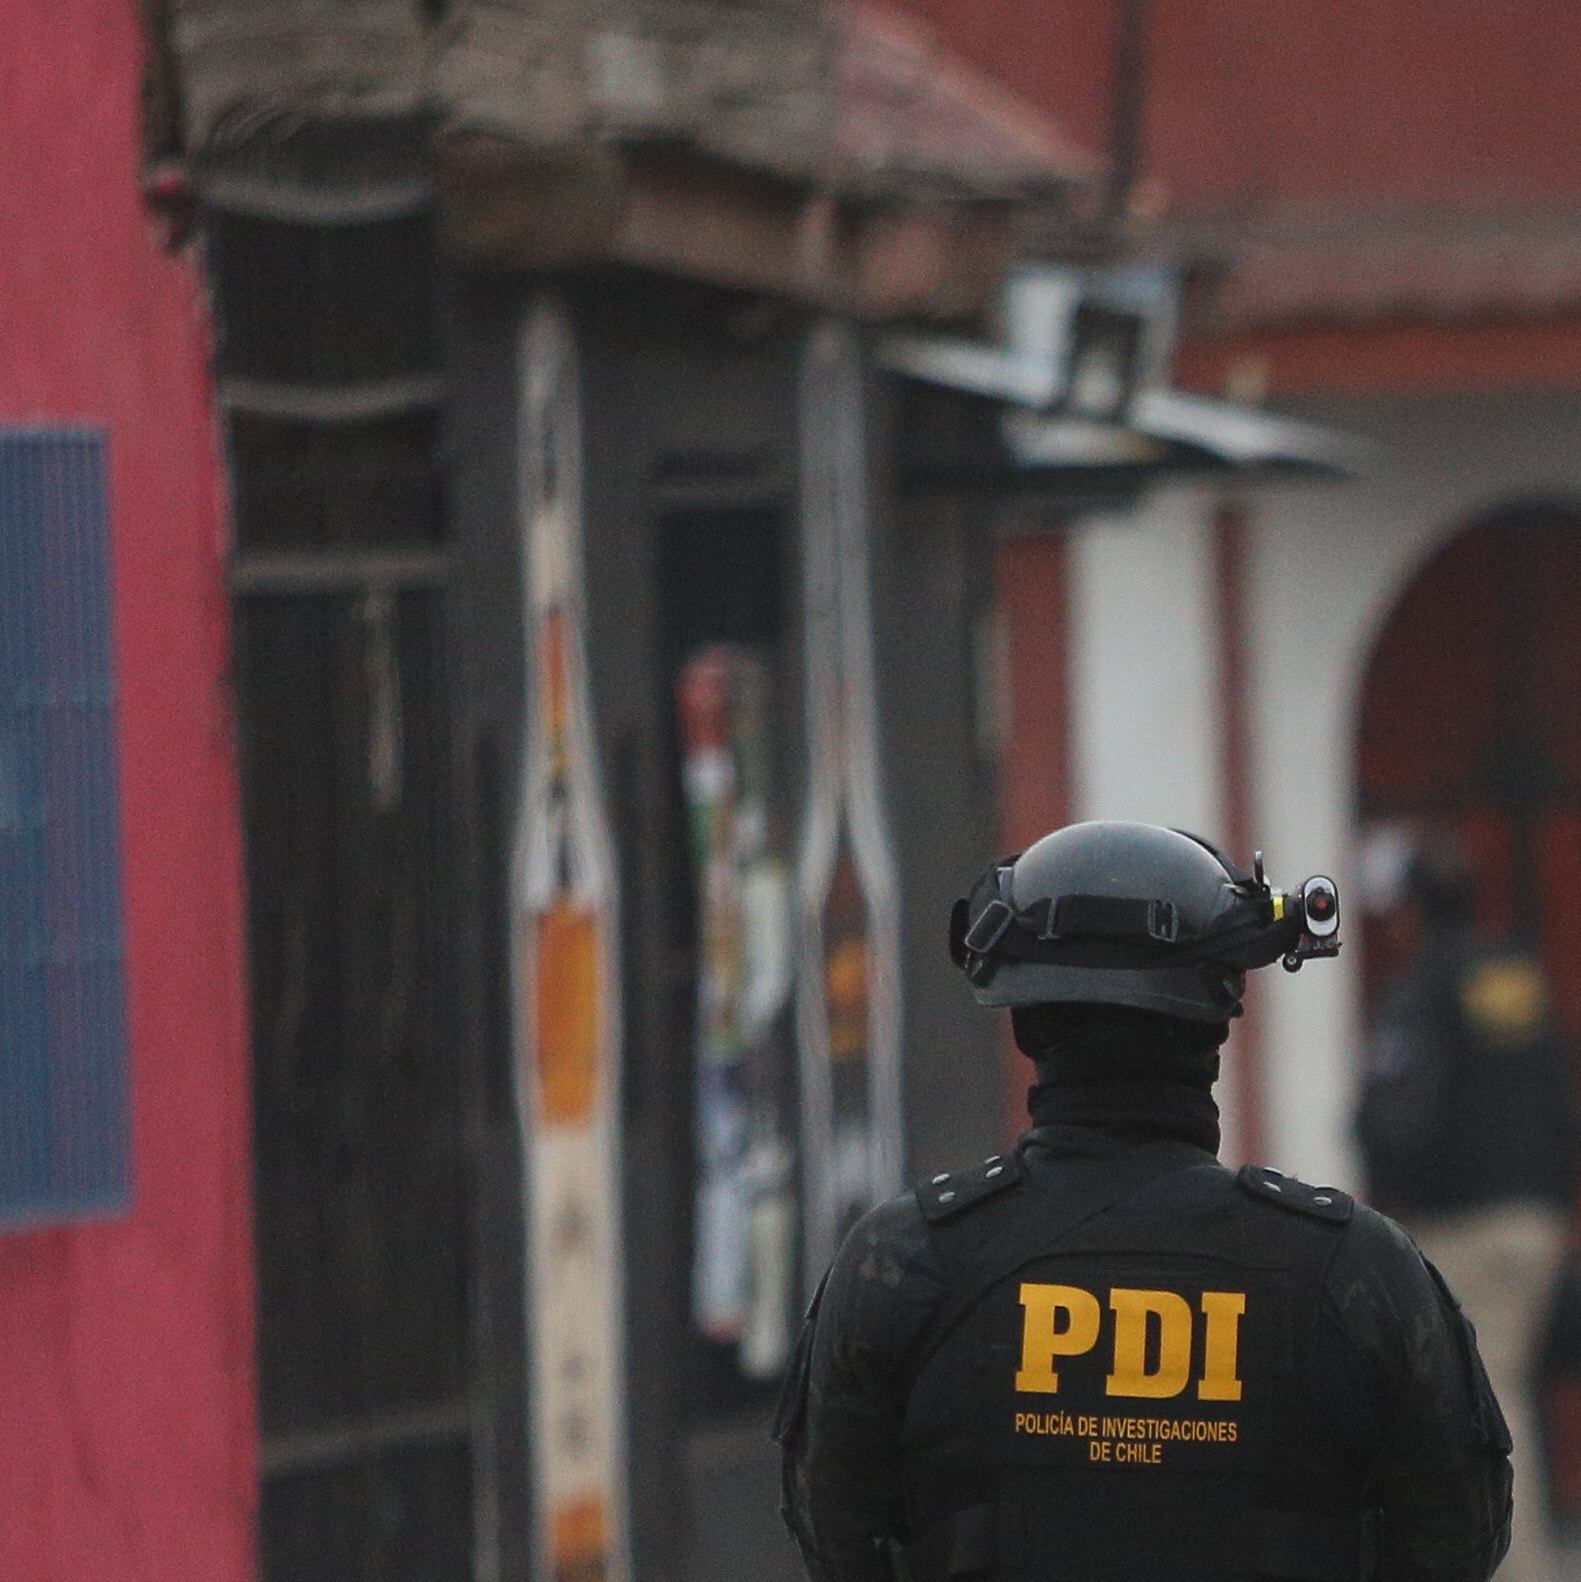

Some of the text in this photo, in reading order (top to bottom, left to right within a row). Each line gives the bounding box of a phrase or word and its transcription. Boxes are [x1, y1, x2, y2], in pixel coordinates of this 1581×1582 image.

[1015, 1282, 1247, 1402] PDI
[1015, 1411, 1239, 1443] POLICÍA DE INVESTIGACIONES
[1089, 1441, 1162, 1464] DE CHILE
